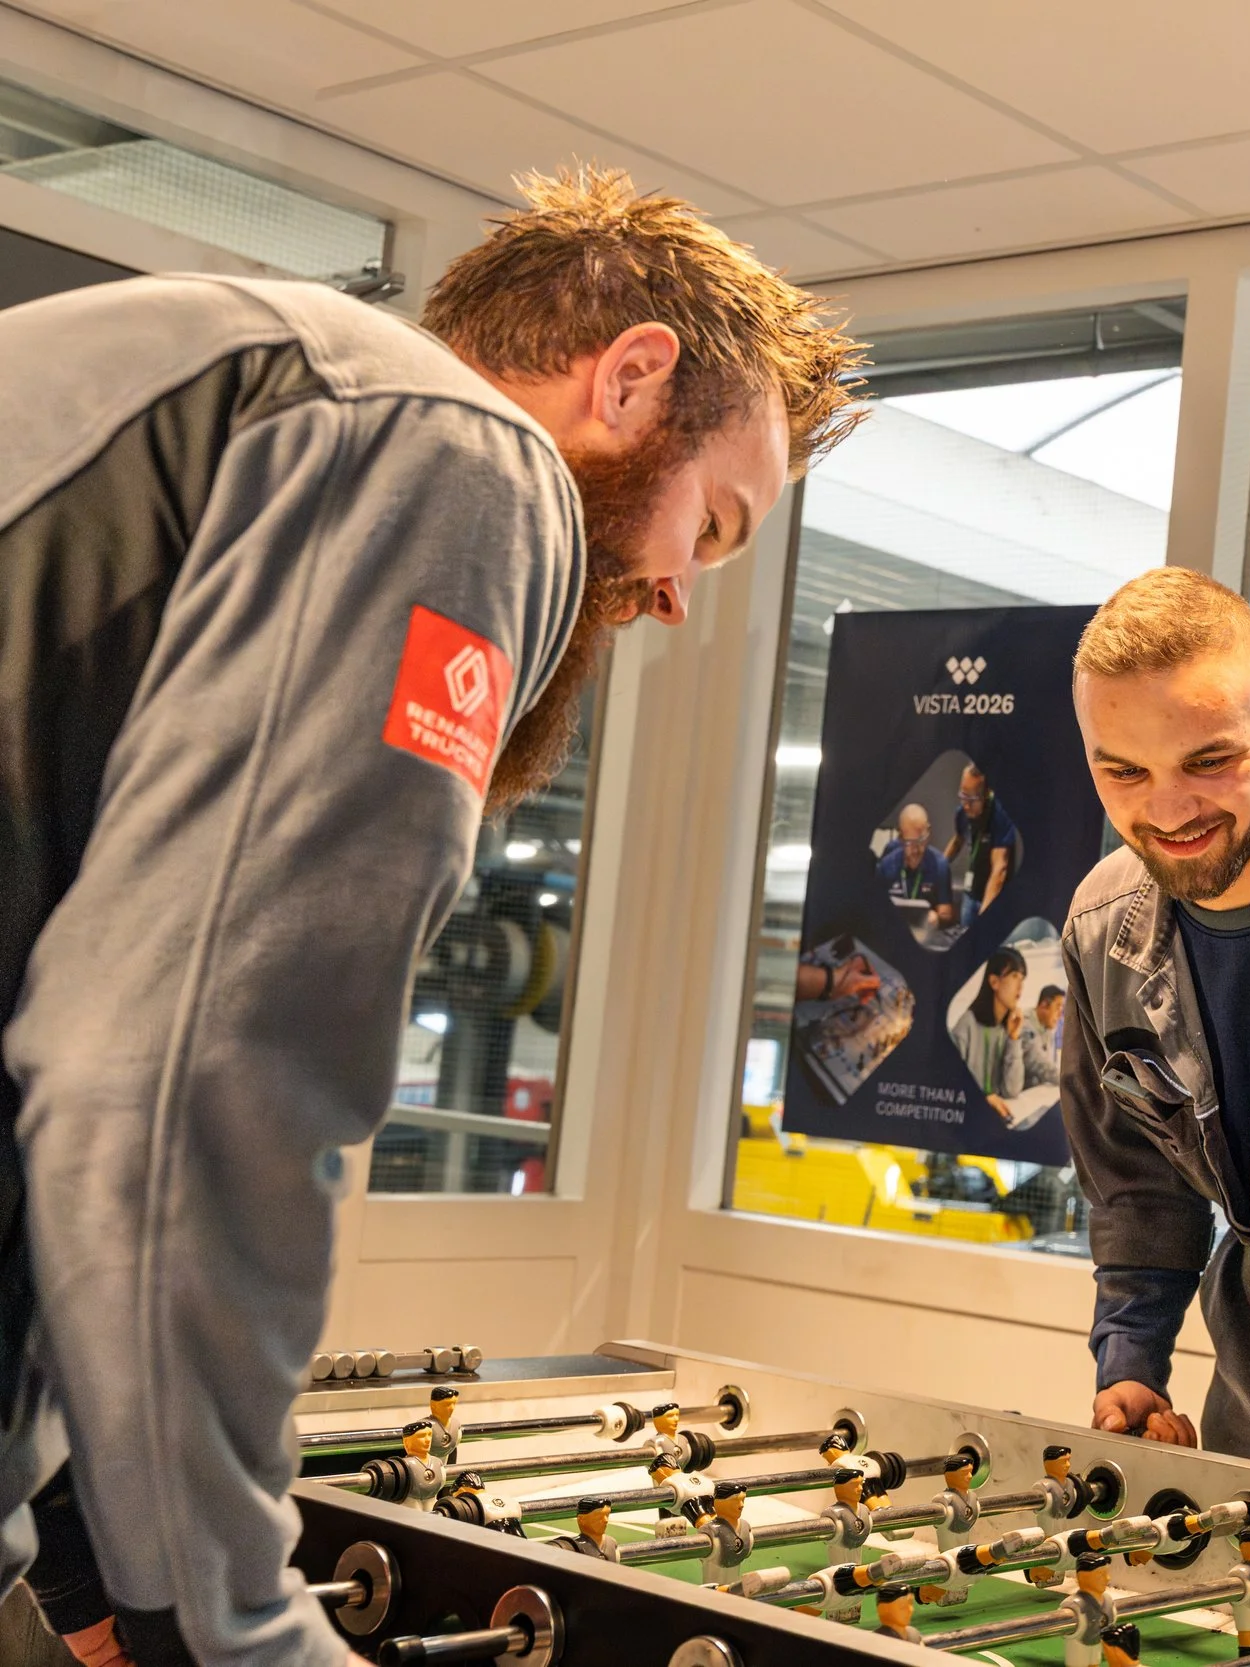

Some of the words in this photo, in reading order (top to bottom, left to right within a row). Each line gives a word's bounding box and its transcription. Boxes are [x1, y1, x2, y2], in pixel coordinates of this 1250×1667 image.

[913, 694, 961, 714] VISTA
[963, 693, 1015, 714] 2026
[877, 1082, 917, 1099] MORE
[919, 1085, 955, 1103] THAN
[956, 1090, 967, 1105] A
[875, 1101, 965, 1125] COMPETITION
